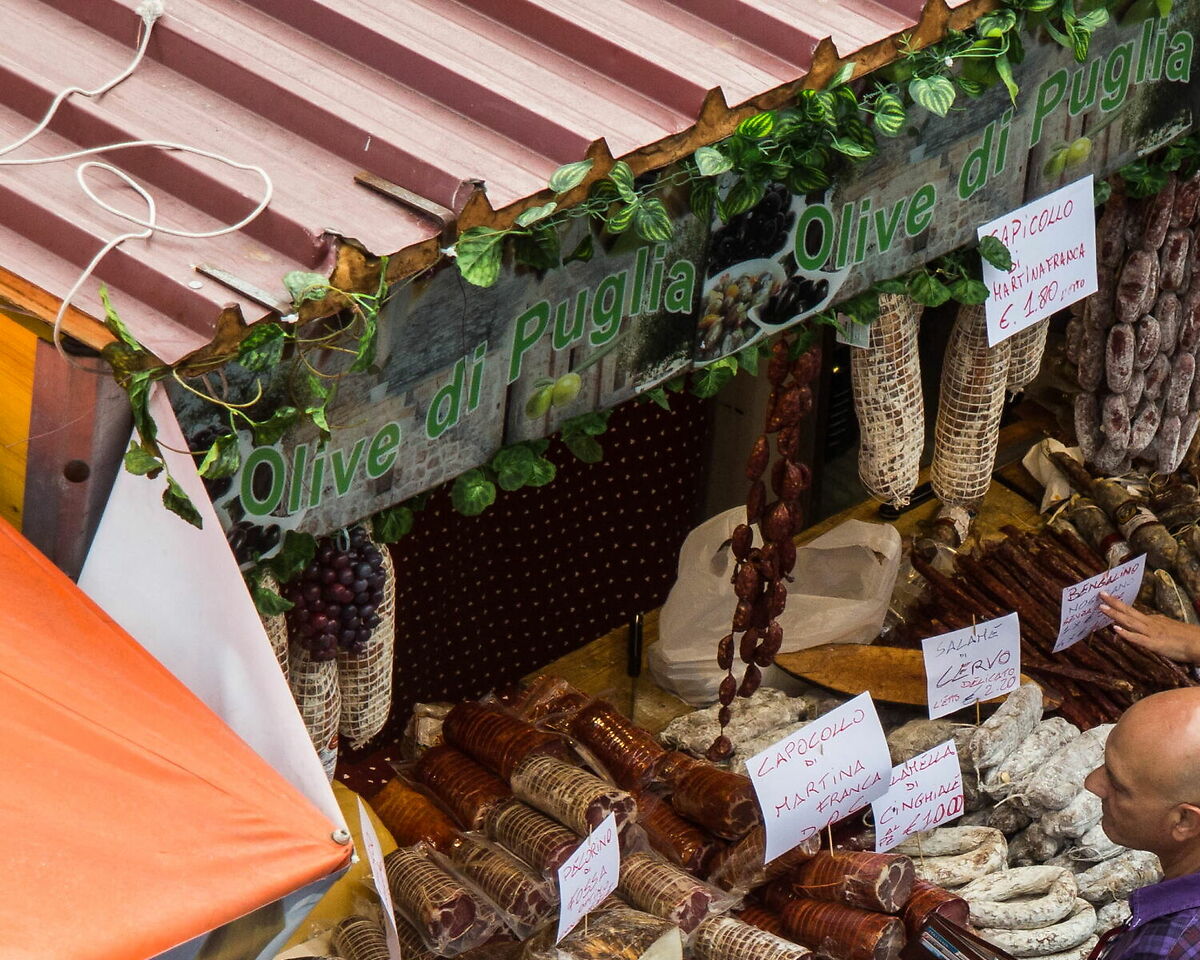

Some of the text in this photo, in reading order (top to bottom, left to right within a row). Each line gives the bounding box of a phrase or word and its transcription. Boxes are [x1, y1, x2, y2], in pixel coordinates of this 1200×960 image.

[794, 17, 1195, 272] Olive di Puglia
[239, 244, 698, 518] Olive di Puglia
[1067, 563, 1140, 602] BENGALINO
[936, 648, 1011, 689] CERVO
[757, 708, 866, 778] CAPOCOLLO
[804, 757, 818, 768] DI
[775, 759, 866, 819] MARTINA
[815, 771, 882, 813] FRANCA
[906, 781, 919, 792] DI
